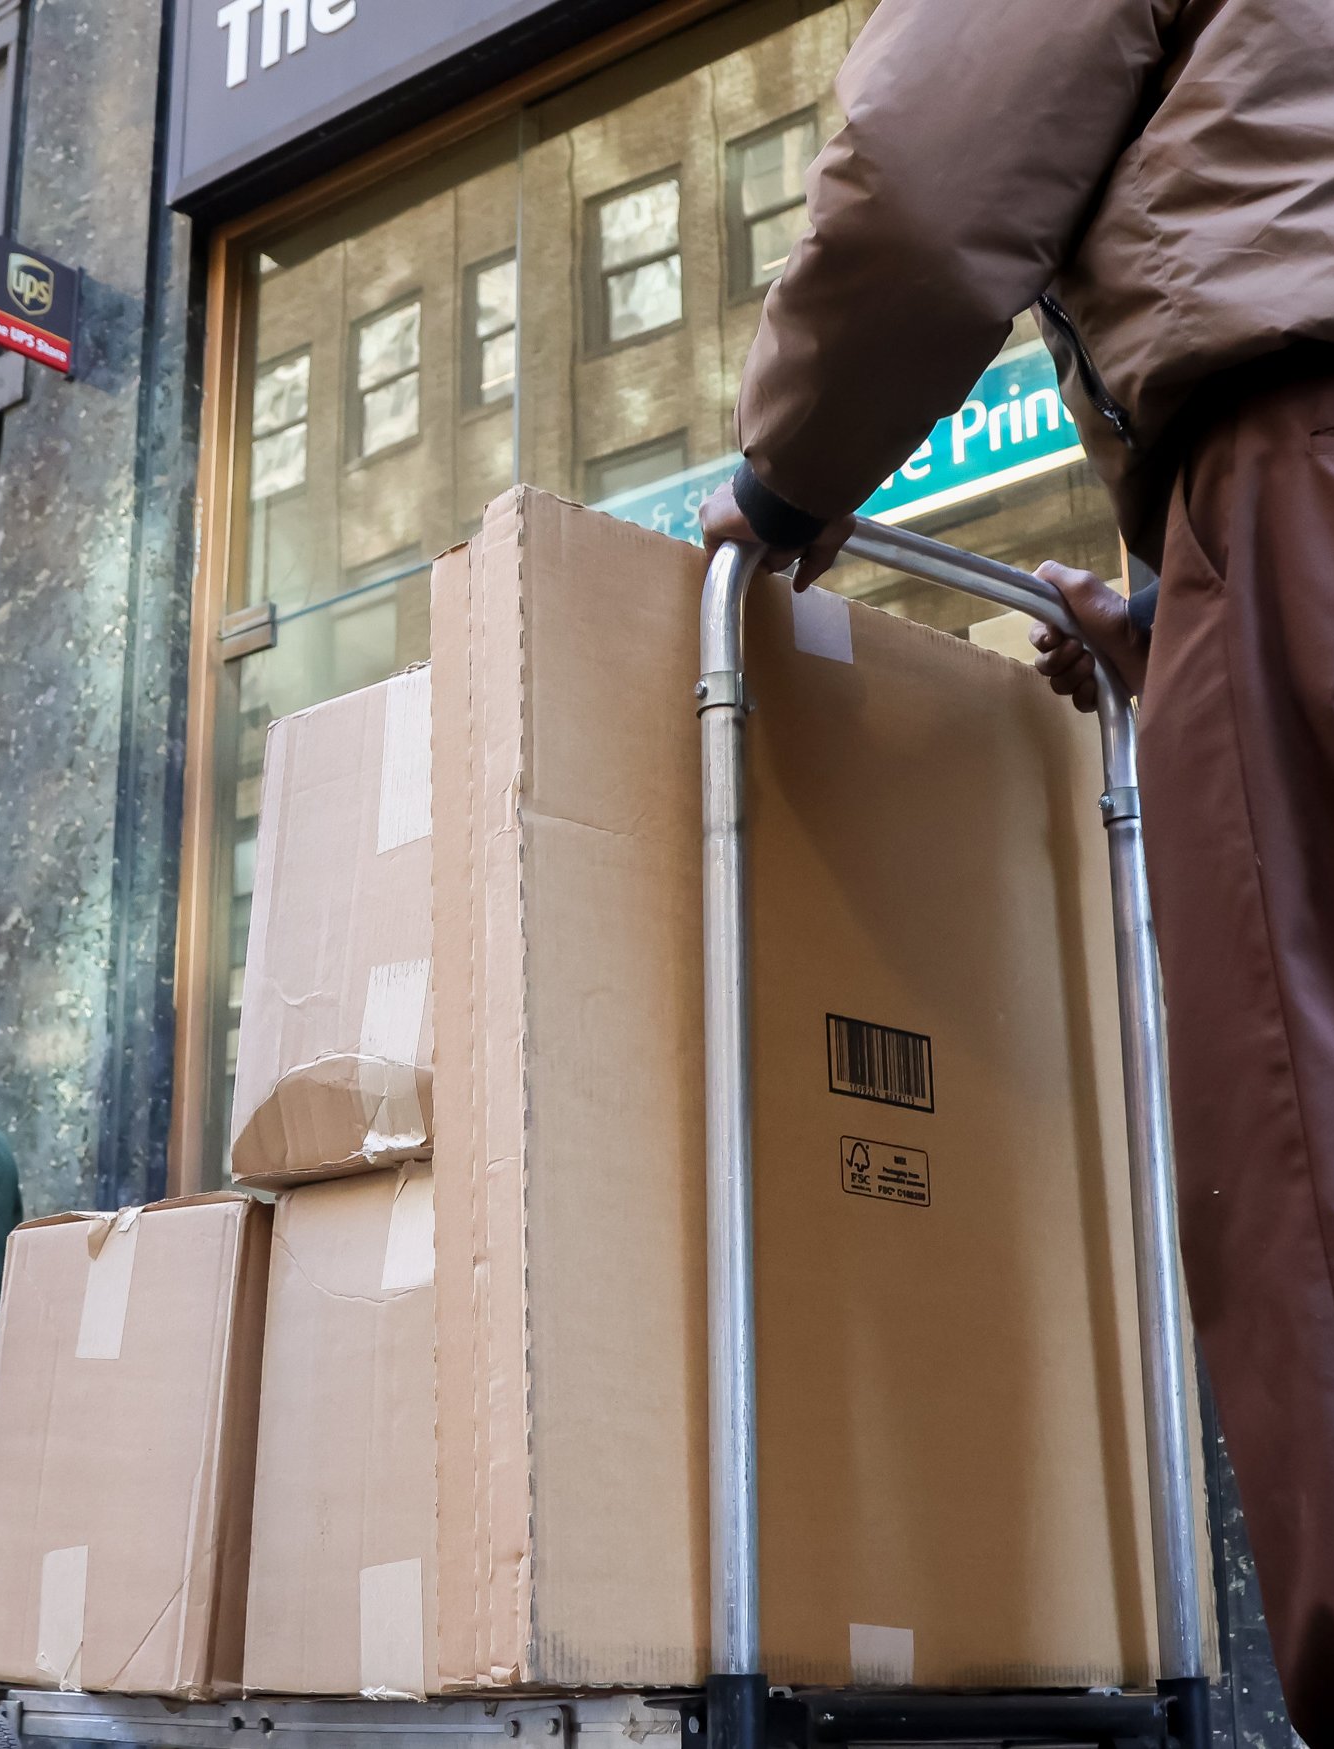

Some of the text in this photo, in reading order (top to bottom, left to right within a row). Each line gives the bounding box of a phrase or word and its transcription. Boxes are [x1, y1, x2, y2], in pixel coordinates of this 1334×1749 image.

[217, 0, 357, 89] The
[12, 270, 51, 305] ups
[10, 326, 35, 348] UPS
[36, 338, 67, 362] Store
[951, 383, 1075, 465] Prin
[851, 1172, 871, 1186] FSC
